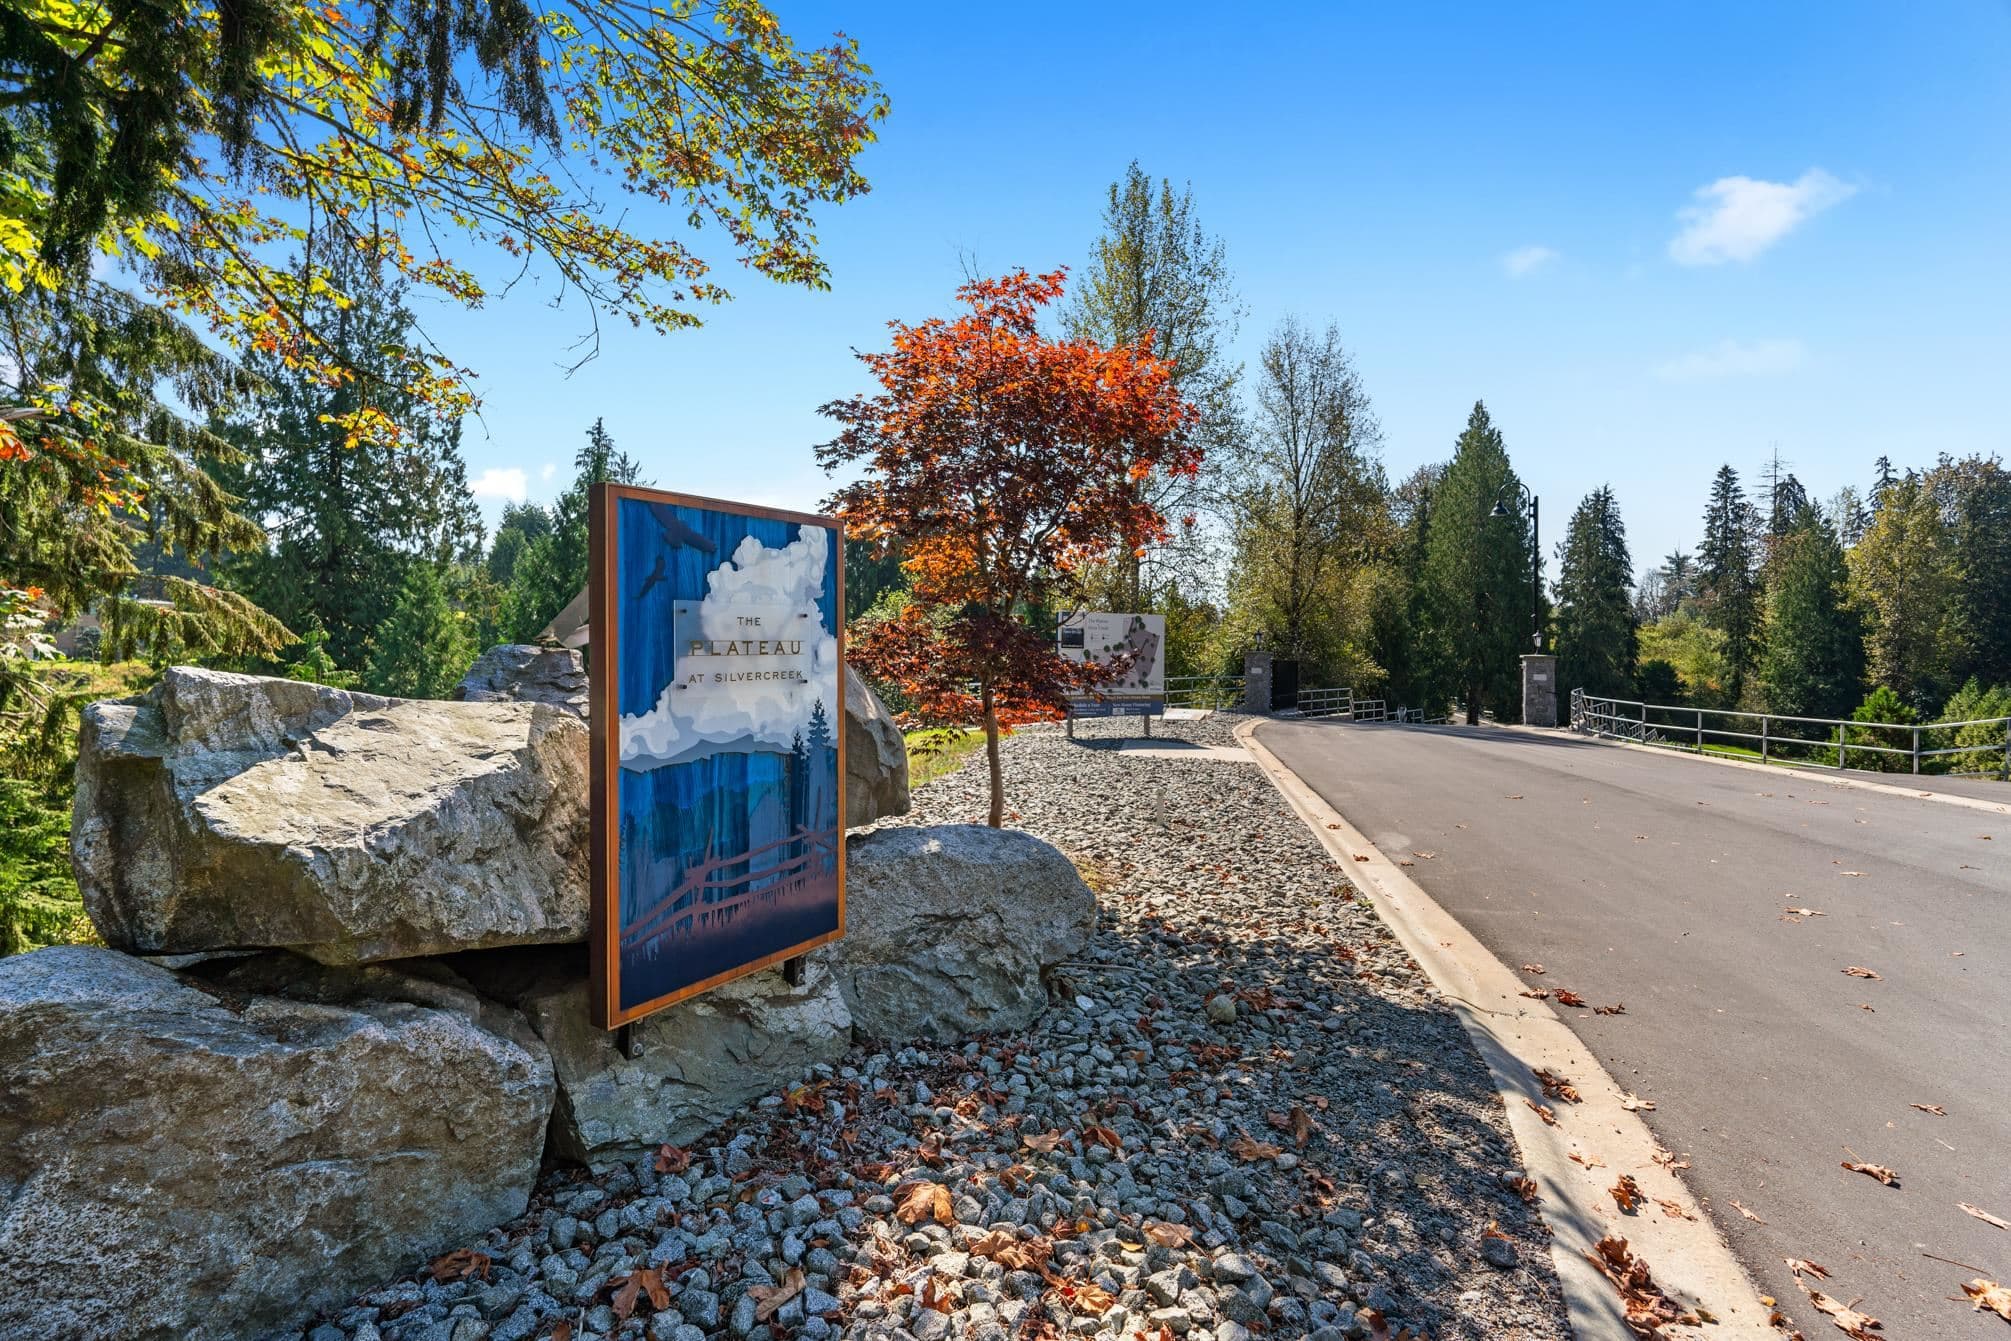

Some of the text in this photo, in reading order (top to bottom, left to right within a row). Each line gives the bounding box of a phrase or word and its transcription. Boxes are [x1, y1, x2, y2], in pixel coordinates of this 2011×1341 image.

[737, 616, 761, 626] THE
[691, 641, 801, 656] PLATEAU
[688, 670, 803, 684] AT SILVERCREEK
